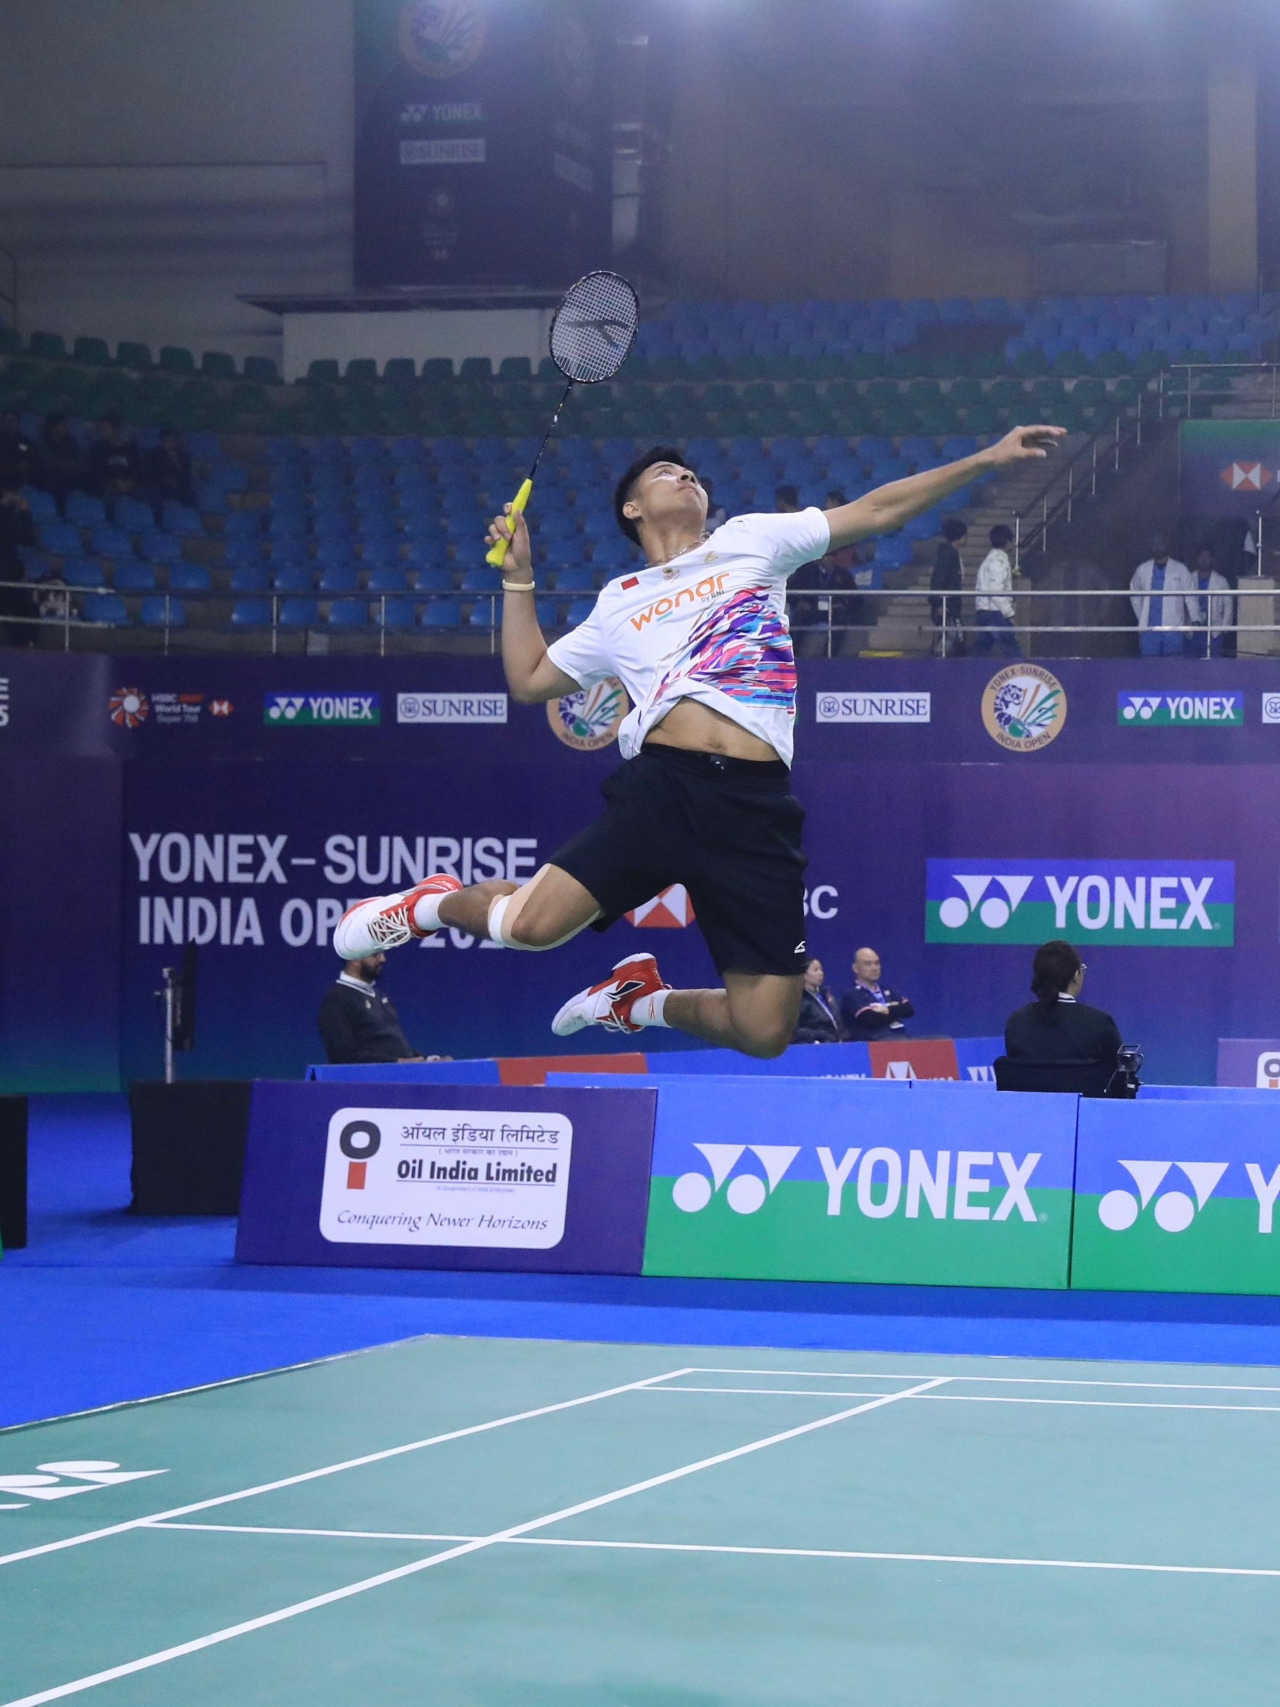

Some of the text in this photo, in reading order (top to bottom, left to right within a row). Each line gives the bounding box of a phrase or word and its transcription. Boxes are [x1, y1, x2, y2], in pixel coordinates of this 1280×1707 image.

[630, 573, 730, 632] wondr
[309, 697, 374, 720] YONEX
[421, 699, 505, 718] SUNRISE
[840, 697, 928, 718] SUNRISE
[1166, 696, 1236, 720] YONEX
[996, 731, 1052, 749] INDIA OPEN
[1045, 875, 1214, 931] YONEX
[139, 897, 265, 946] INDIA
[401, 1122, 560, 1145] ऑयल इंडिया लिमिटेड
[397, 1159, 558, 1183] Oil India Limited
[816, 1145, 1042, 1222] YONEX
[337, 1209, 549, 1232] Conquering Newer Horizons
